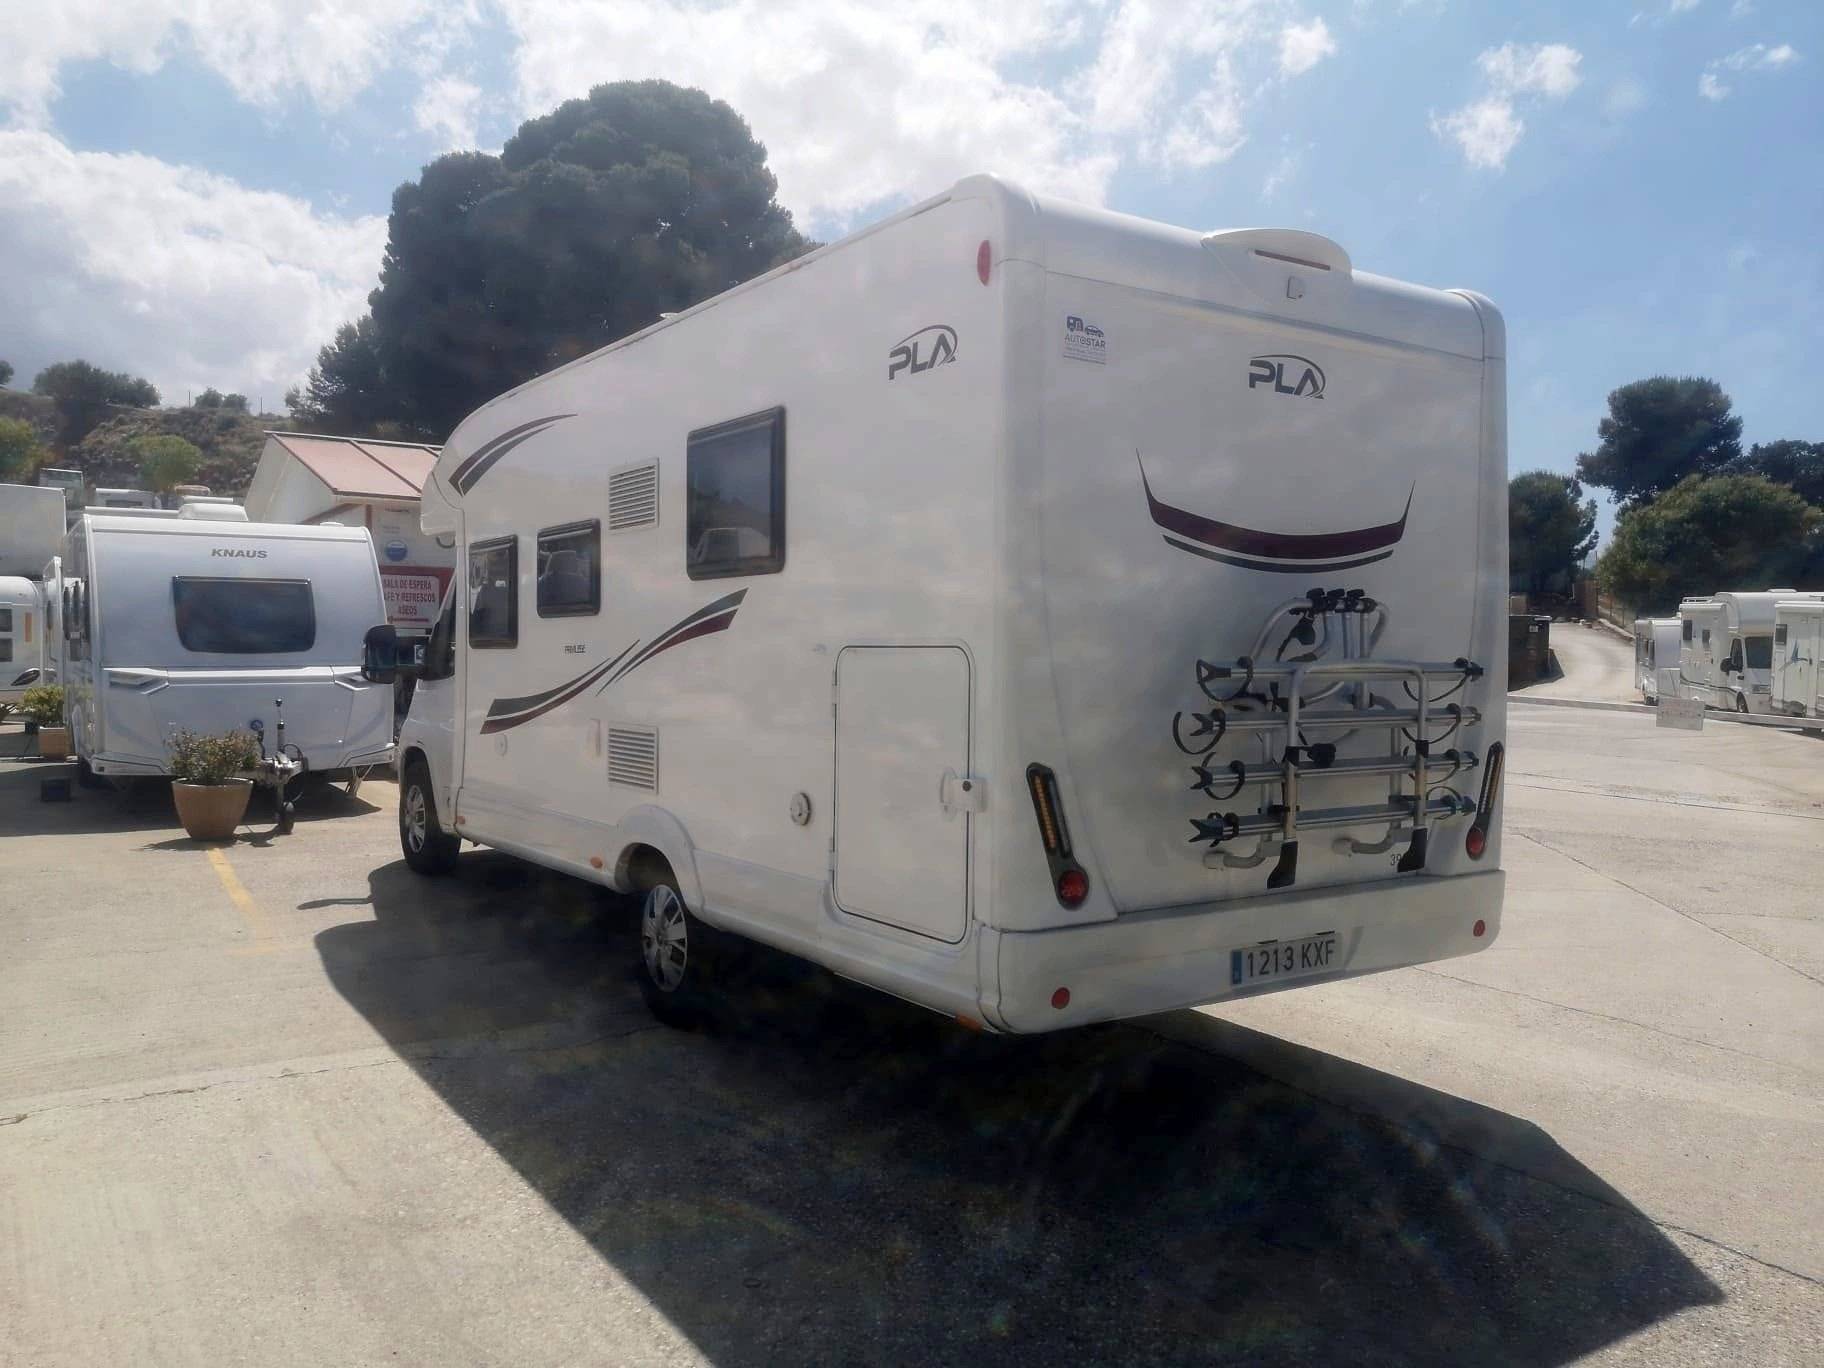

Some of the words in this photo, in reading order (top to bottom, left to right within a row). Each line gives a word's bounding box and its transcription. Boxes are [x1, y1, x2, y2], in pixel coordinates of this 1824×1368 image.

[889, 329, 956, 380] PLA
[1249, 357, 1325, 398] PLA
[211, 549, 268, 558] KNAUS
[410, 580, 432, 590] ESPERA
[1248, 946, 1294, 977] 1213
[1301, 939, 1335, 969] KXF
